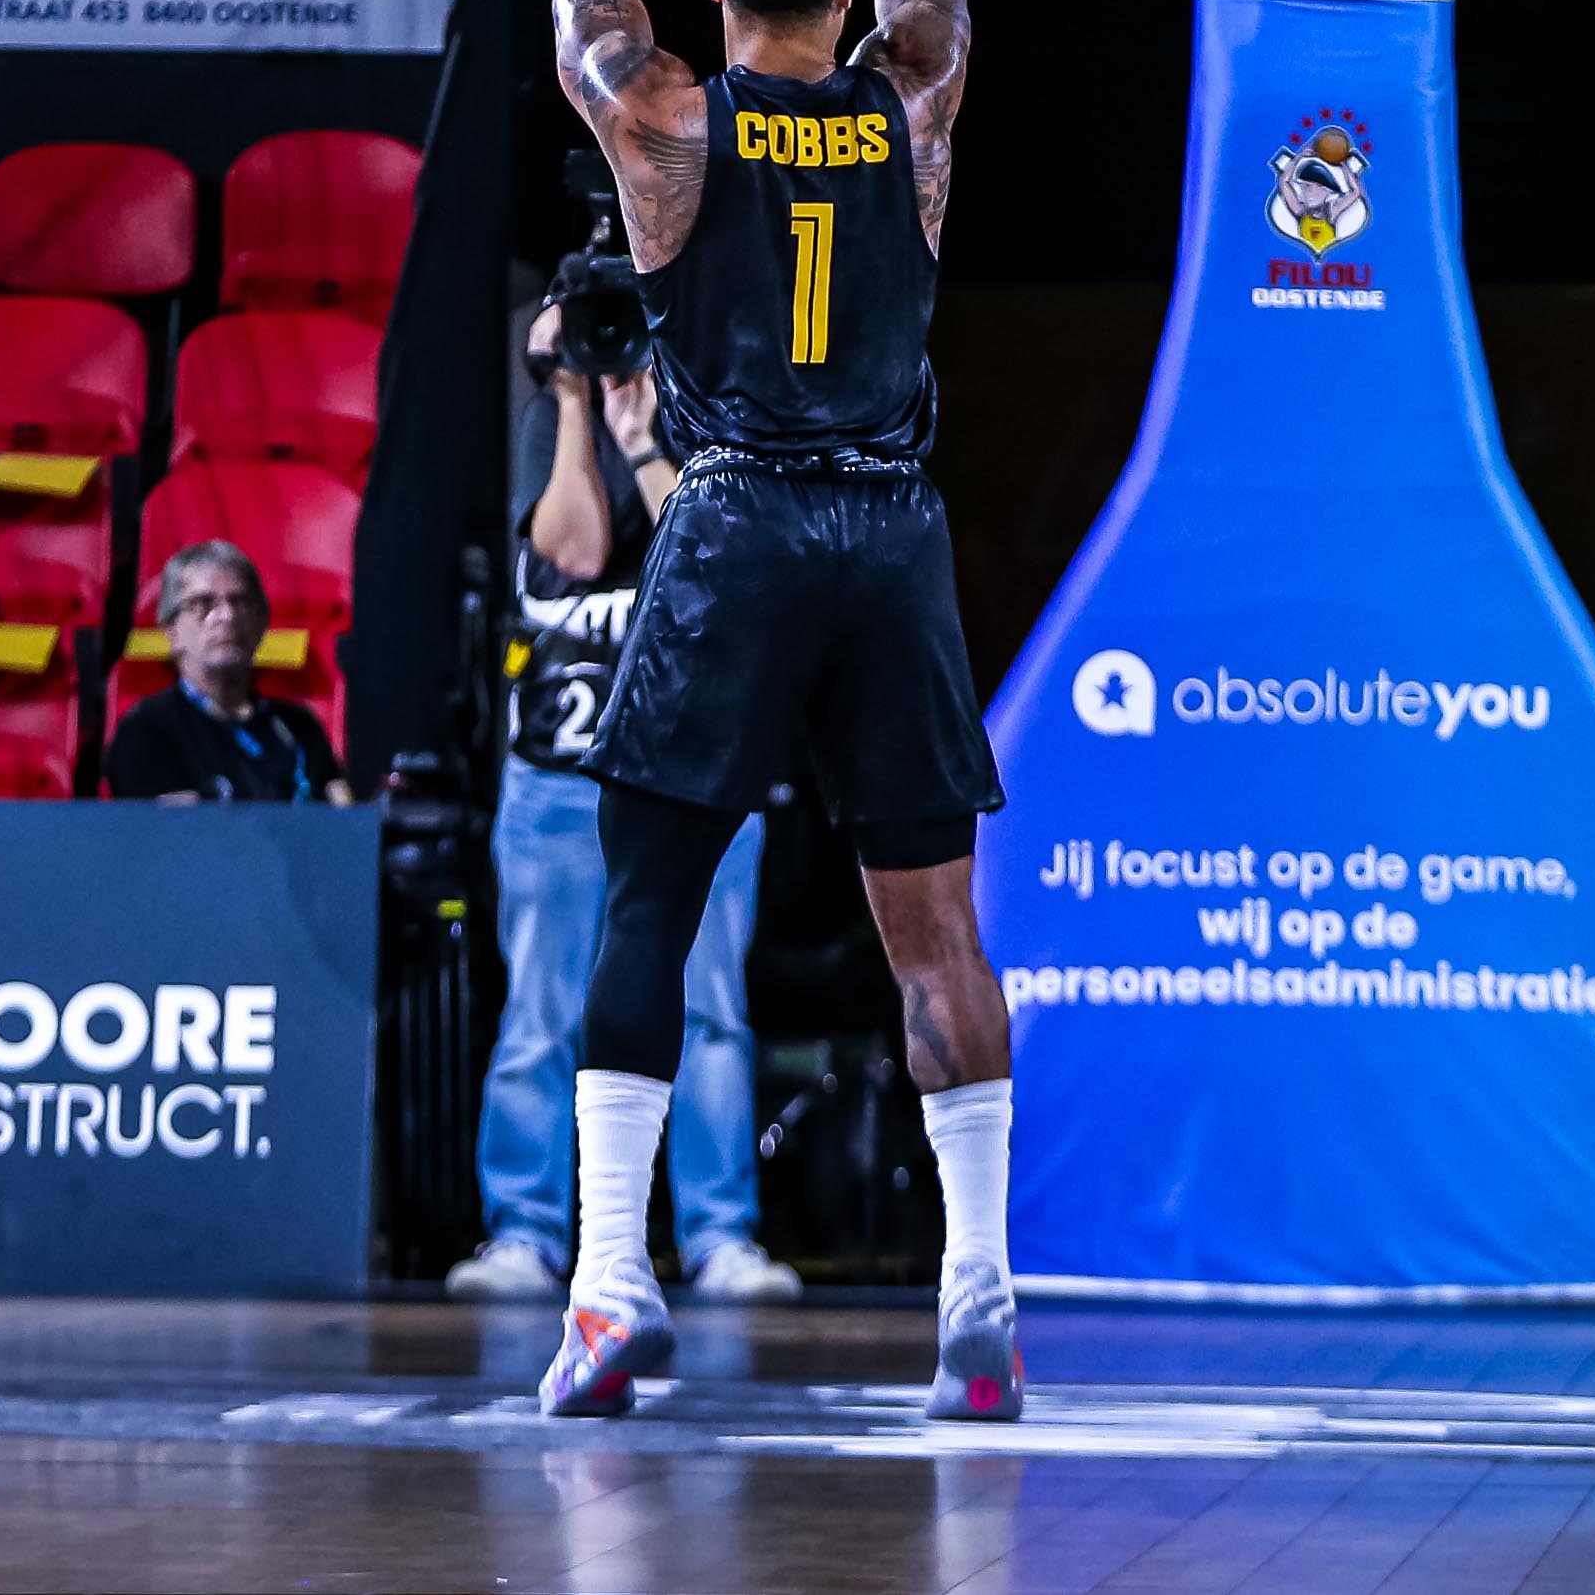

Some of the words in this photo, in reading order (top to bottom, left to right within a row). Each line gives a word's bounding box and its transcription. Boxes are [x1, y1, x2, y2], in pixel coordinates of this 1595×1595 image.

[211, 1, 357, 26] OOSTENDE
[735, 110, 890, 167] COBBS
[790, 202, 834, 364] 1
[1252, 287, 1387, 311] OOSTENDE
[1268, 259, 1373, 288] FILOU
[1172, 666, 1551, 742] absoluteyou
[1040, 840, 1094, 902] Jij
[1106, 840, 1258, 889] focust
[1268, 851, 1335, 901] op
[1343, 846, 1409, 893] de
[1419, 855, 1577, 905] game,
[1199, 898, 1271, 960] wij
[1279, 908, 1347, 961] op
[1352, 903, 1420, 950] de
